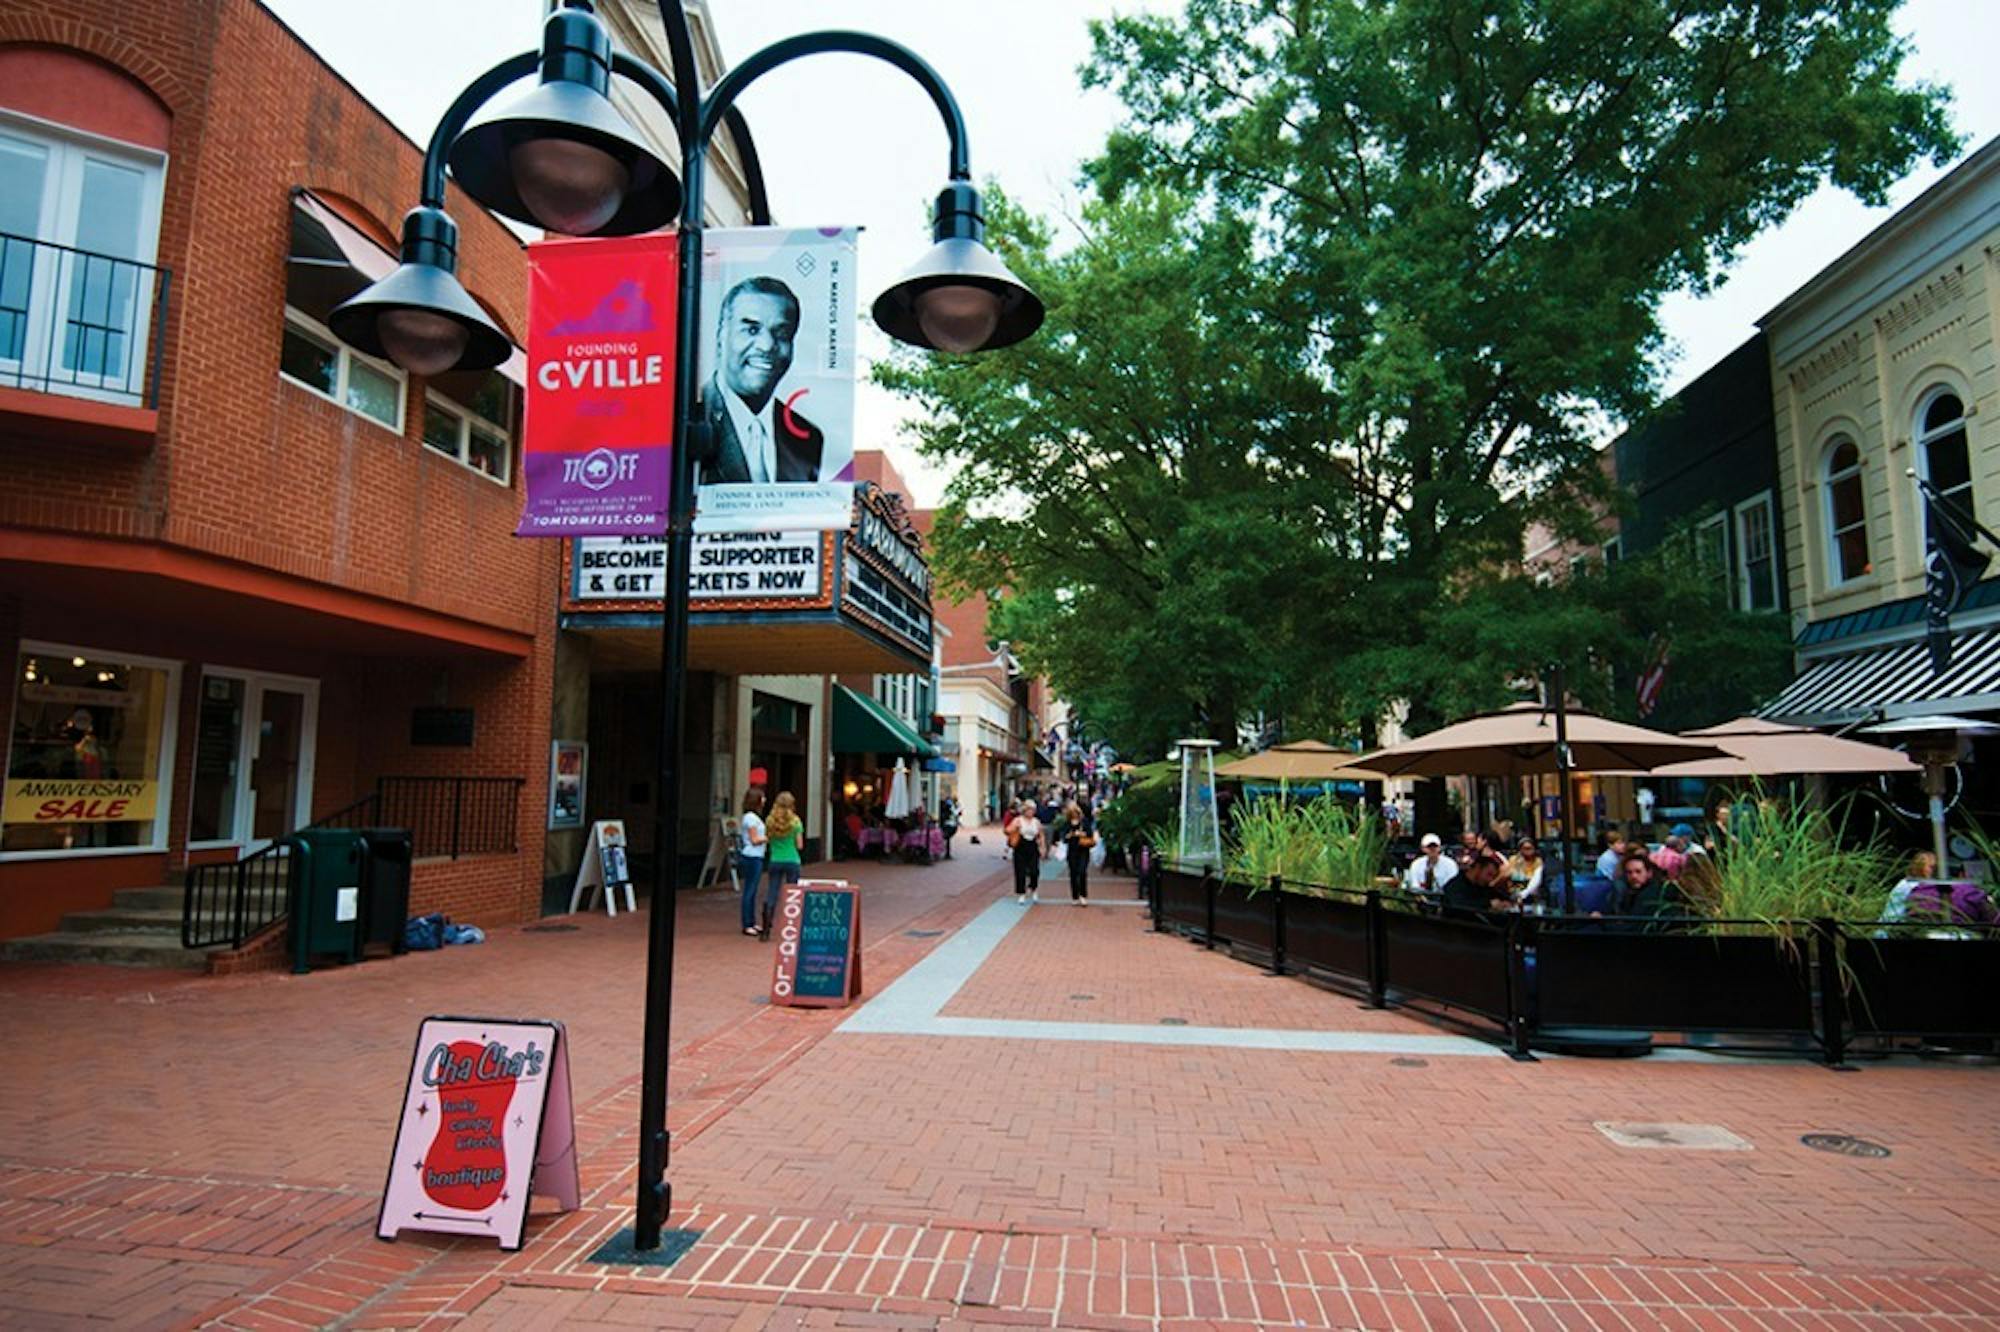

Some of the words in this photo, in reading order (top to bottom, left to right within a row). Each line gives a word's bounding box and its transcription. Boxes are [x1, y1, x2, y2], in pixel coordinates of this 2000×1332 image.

[829, 282, 838, 323] MARCUS
[567, 341, 637, 356] FOUNDING
[828, 328, 837, 369] MARTIN
[538, 355, 662, 390] CVILLE
[533, 514, 656, 526] TOMTOMFEST.COM
[583, 550, 664, 568] BECOME
[700, 548, 815, 566] SUPPORTER
[590, 576, 604, 592] &
[614, 574, 654, 592] GET
[688, 573, 749, 590] CKETS
[758, 571, 806, 589] NOW
[16, 782, 145, 797] ANNIVERSARY
[34, 800, 130, 820] SALE
[423, 1042, 472, 1088] Cha
[477, 1040, 545, 1080] Cha's
[427, 1167, 503, 1190] boutique
